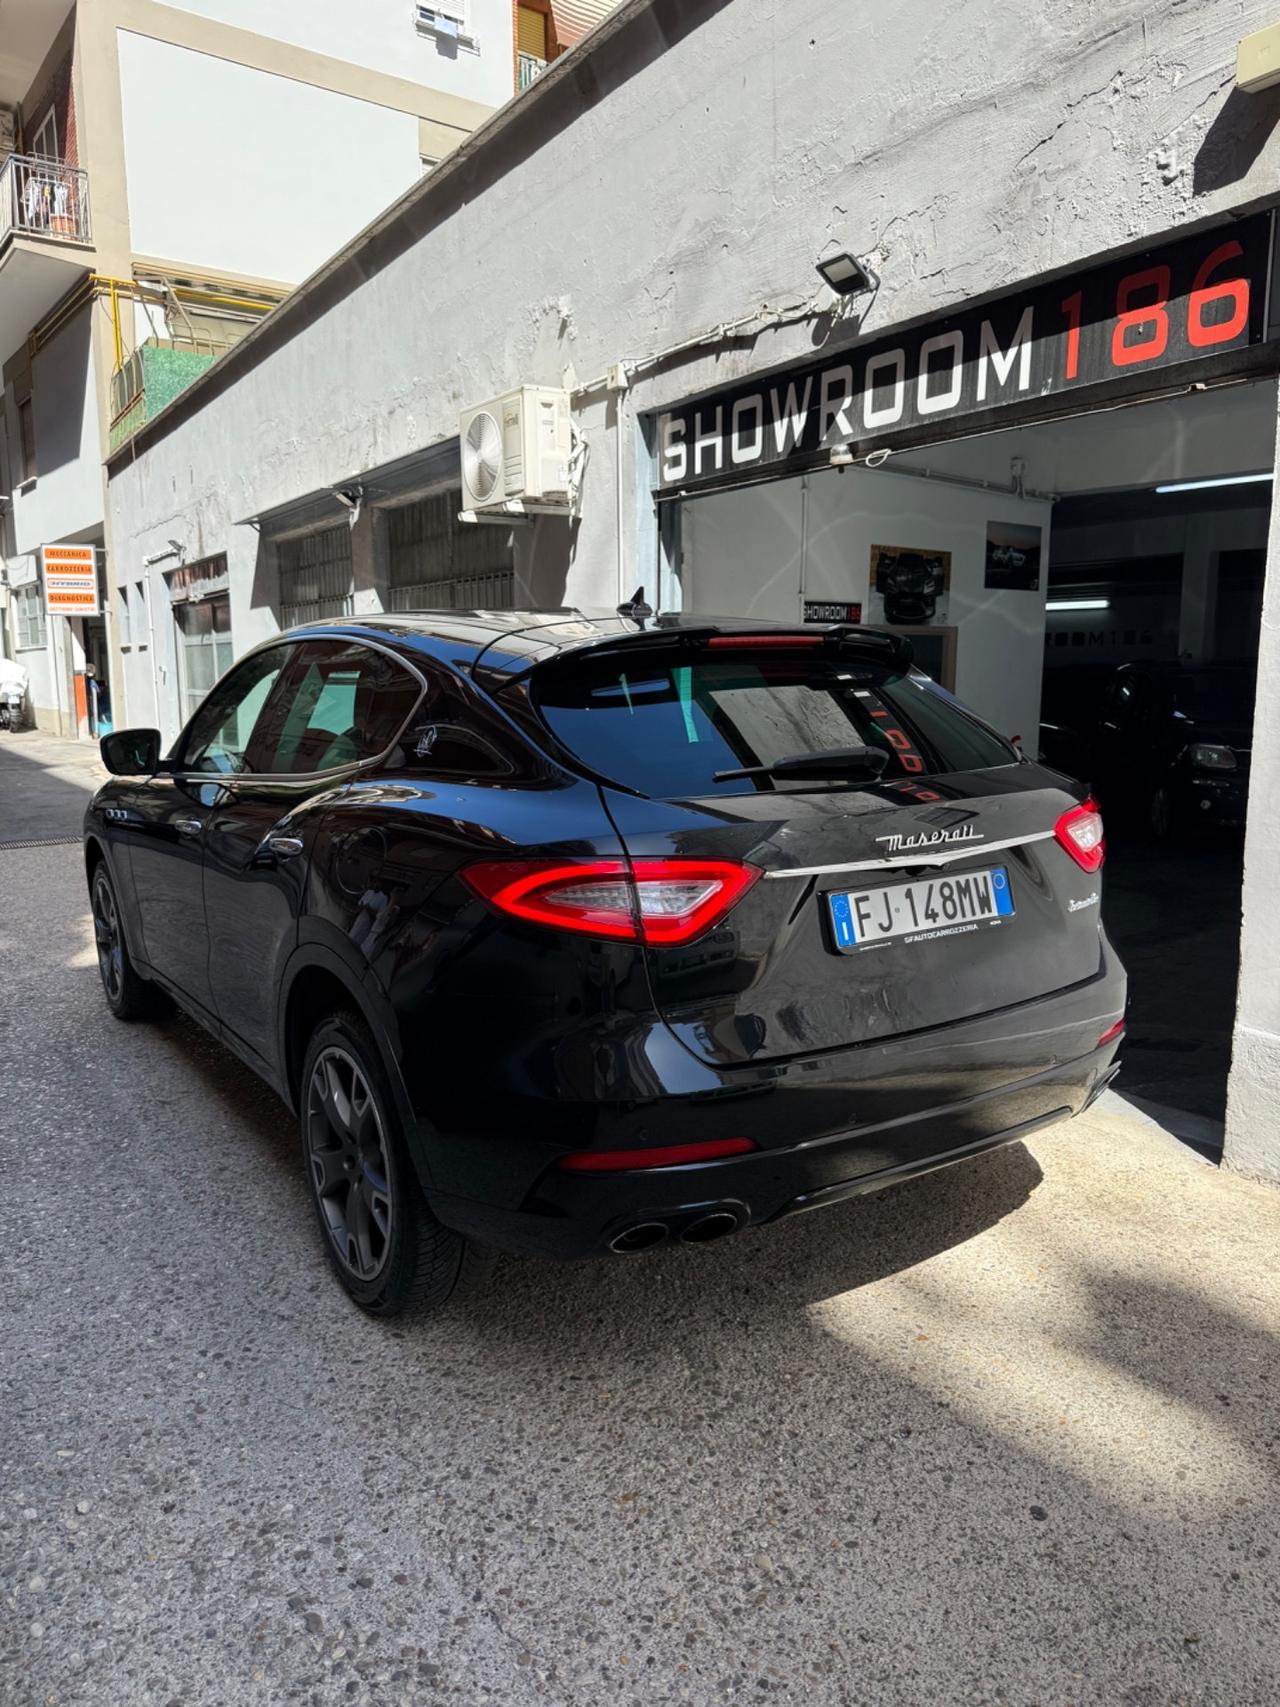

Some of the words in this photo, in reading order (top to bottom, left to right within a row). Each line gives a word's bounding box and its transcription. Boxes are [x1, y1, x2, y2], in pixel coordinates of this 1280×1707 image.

[661, 305, 1032, 483] SHOWROOM
[1061, 240, 1251, 380] 186
[803, 605, 848, 620] SHOWROOM
[875, 824, 984, 852] Maserati
